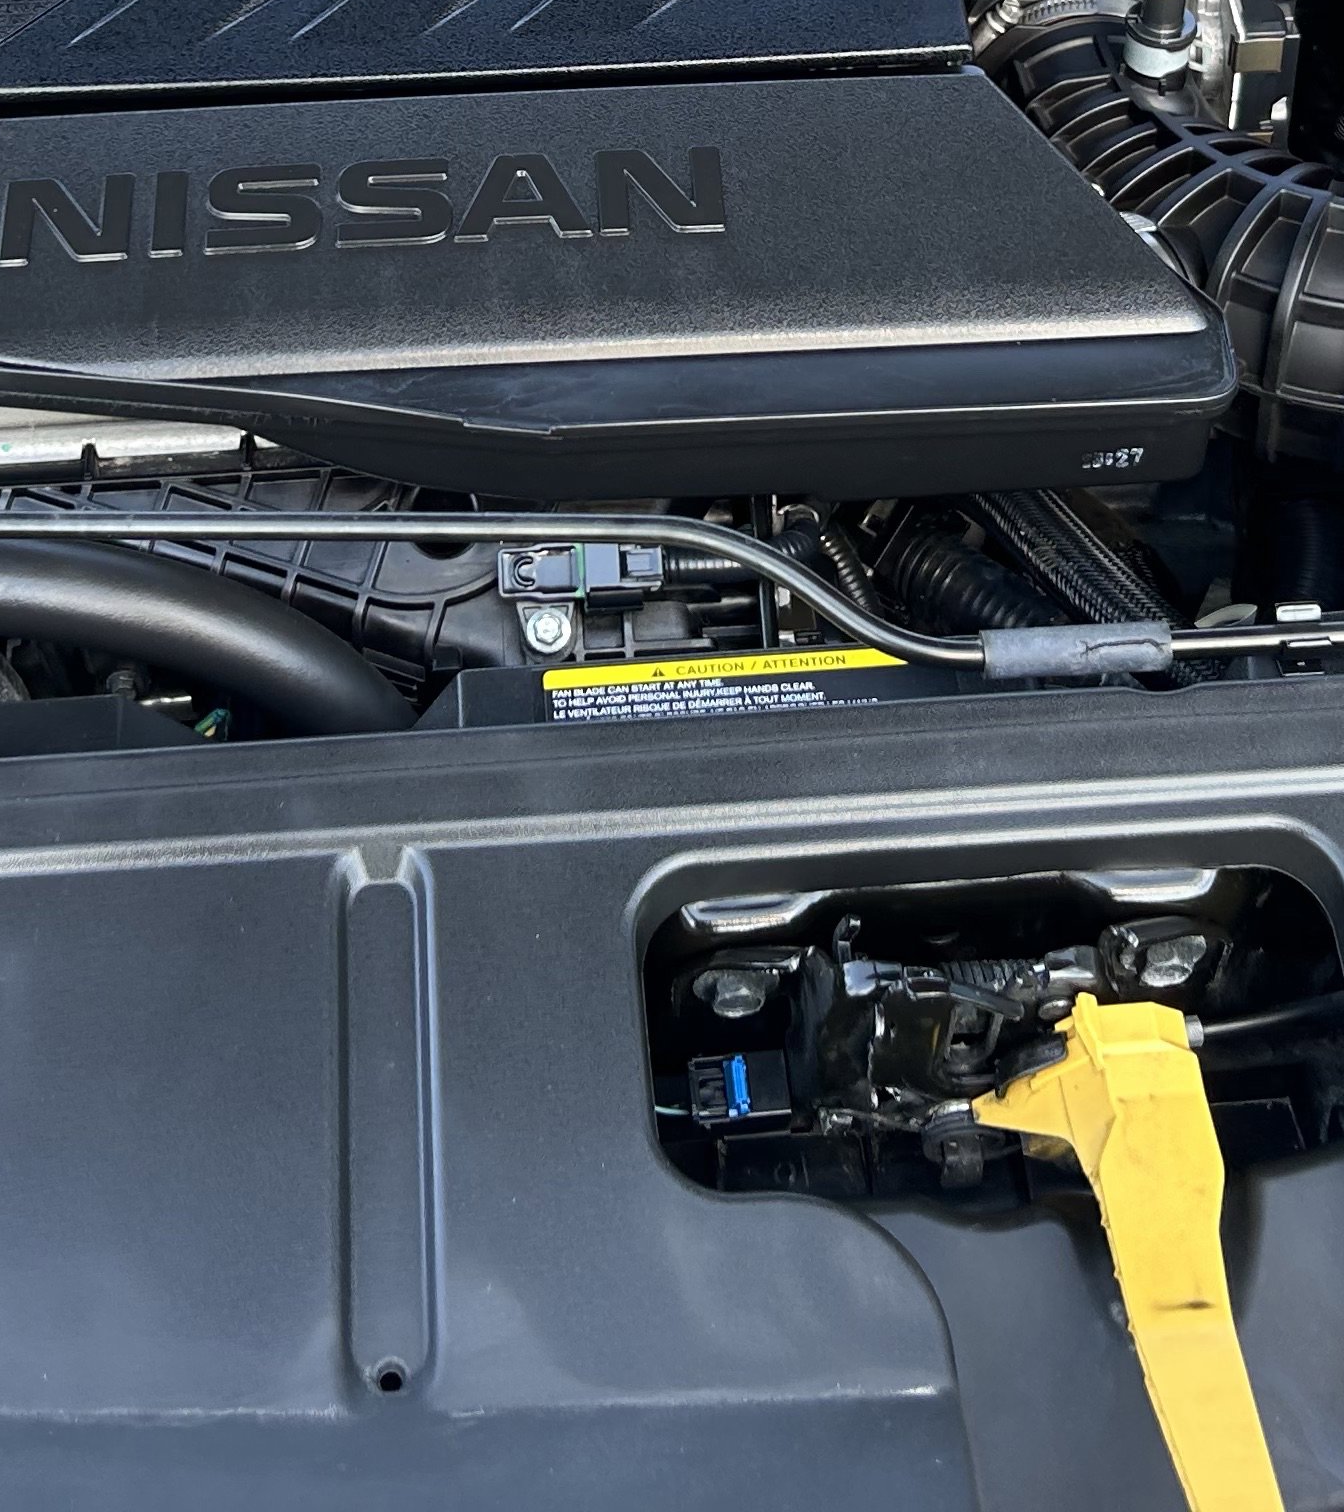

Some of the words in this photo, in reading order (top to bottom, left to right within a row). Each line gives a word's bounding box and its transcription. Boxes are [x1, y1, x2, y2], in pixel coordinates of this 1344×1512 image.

[675, 661, 745, 676] CAUTION
[762, 654, 847, 670] ATTENTION
[552, 688, 572, 699] FAN
[573, 686, 606, 697] BLADE
[607, 685, 629, 695] CAN
[631, 683, 662, 694] START
[663, 681, 675, 691] AT
[674, 680, 698, 690] ANY
[552, 698, 567, 708] TO
[568, 696, 595, 707] HELP
[595, 695, 627, 705] AVOID
[628, 691, 681, 703] PERSONAL
[743, 683, 779, 694] HANDS
[553, 709, 566, 720] LE
[567, 704, 632, 719] VENTILATEUR
[632, 702, 672, 714] RISQUE
[672, 700, 687, 711] DE
[687, 696, 742, 709] DÉMARRER
[753, 694, 779, 705] TOUT
